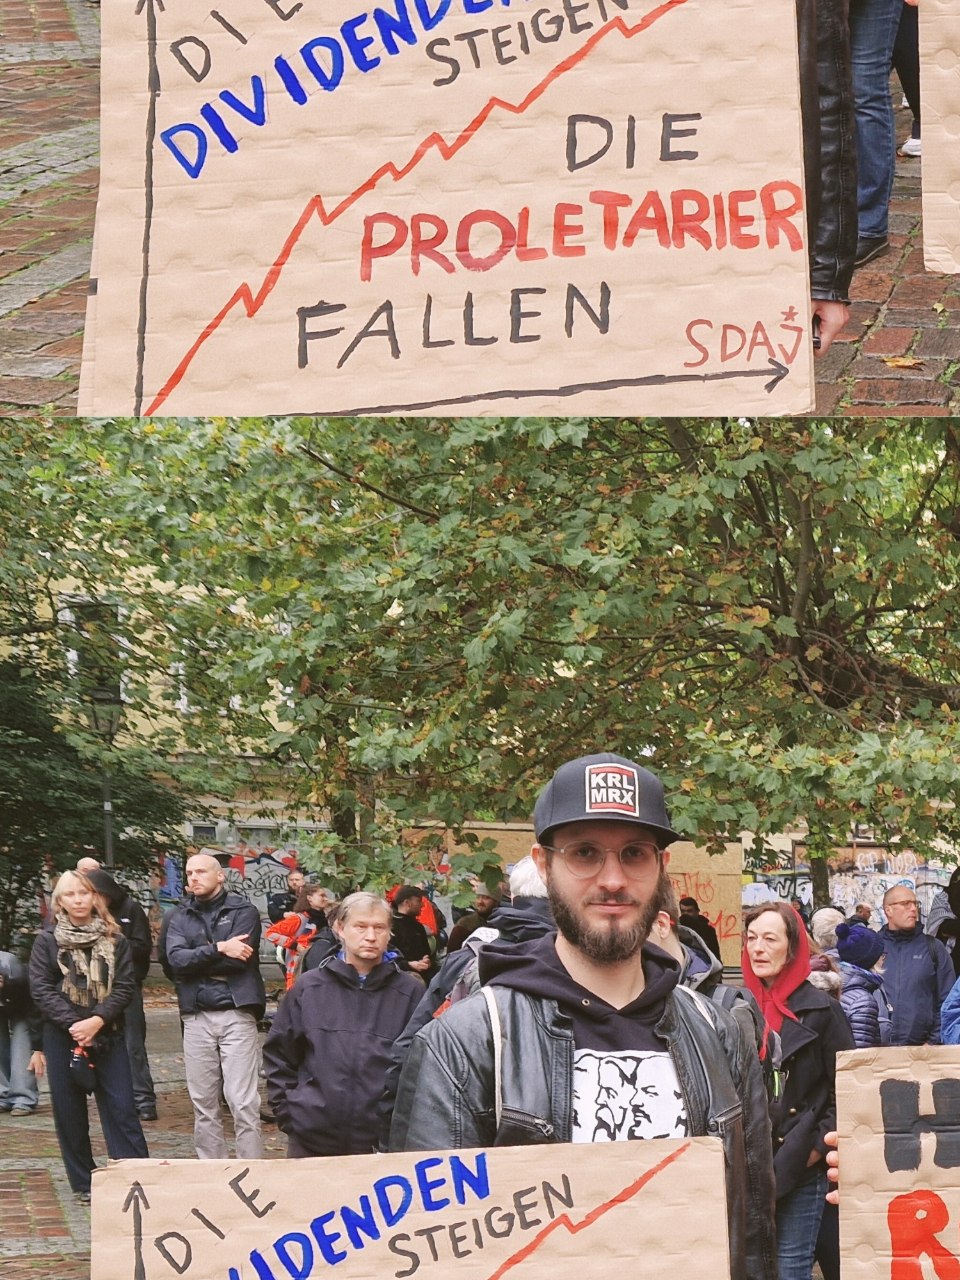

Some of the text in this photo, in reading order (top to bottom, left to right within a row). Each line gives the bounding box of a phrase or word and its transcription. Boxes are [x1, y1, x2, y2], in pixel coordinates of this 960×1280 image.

[565, 113, 702, 172] DIE
[360, 180, 804, 281] PROLETARIER
[297, 282, 611, 369] FALLEN
[684, 305, 804, 368] SDAJ
[591, 773, 634, 790] KRL
[591, 789, 634, 805] MRX
[153, 1167, 276, 1275] DIE
[387, 1173, 575, 1278] STEIGEN
